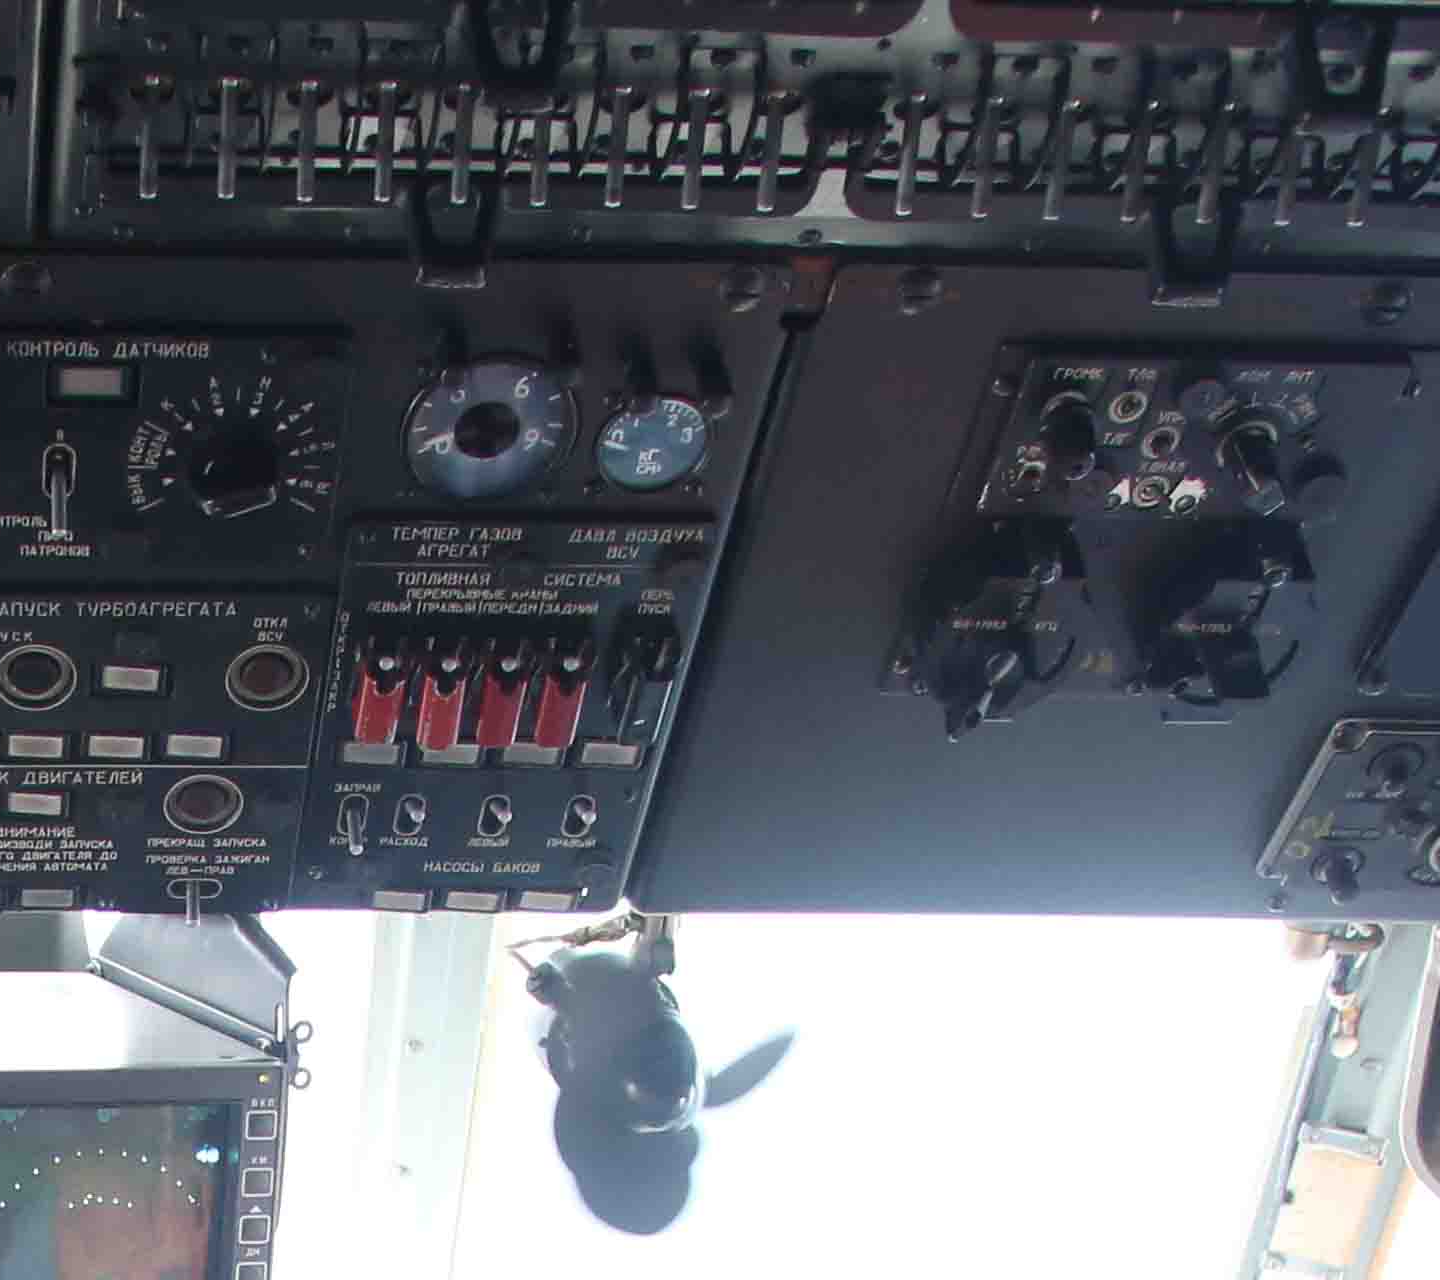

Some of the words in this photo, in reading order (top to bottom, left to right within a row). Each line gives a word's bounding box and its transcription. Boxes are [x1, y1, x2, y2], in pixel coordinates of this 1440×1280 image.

[7, 342, 99, 359] КОНТРОЛЬ
[113, 341, 209, 360] ДАТЧИКОВ
[392, 526, 461, 542] ТЕМПЕР
[469, 526, 524, 542] ГАЗОВ
[19, 545, 91, 558] ПАТРОНОВ
[417, 543, 491, 558] АГРЕГАТ
[396, 571, 491, 587] ТОПЛИВНАЯ
[543, 572, 623, 587] СИСТЕМА
[75, 601, 239, 617] ТУРБОАГРЕГАТА
[22, 771, 144, 787] ДВИГАТЕЛЕЙ
[58, 839, 117, 851] ЗАПУСКА
[212, 837, 268, 849] ЗАПУСКА
[20, 851, 94, 862] ДВИГАТЕЛЯ
[99, 851, 119, 862] ДО
[144, 853, 207, 866] ПРОВЕРКА
[213, 853, 270, 866] ЗАЖИГАН
[42, 862, 110, 874] АВТОМАТА
[422, 860, 484, 875] НАСОСЫ
